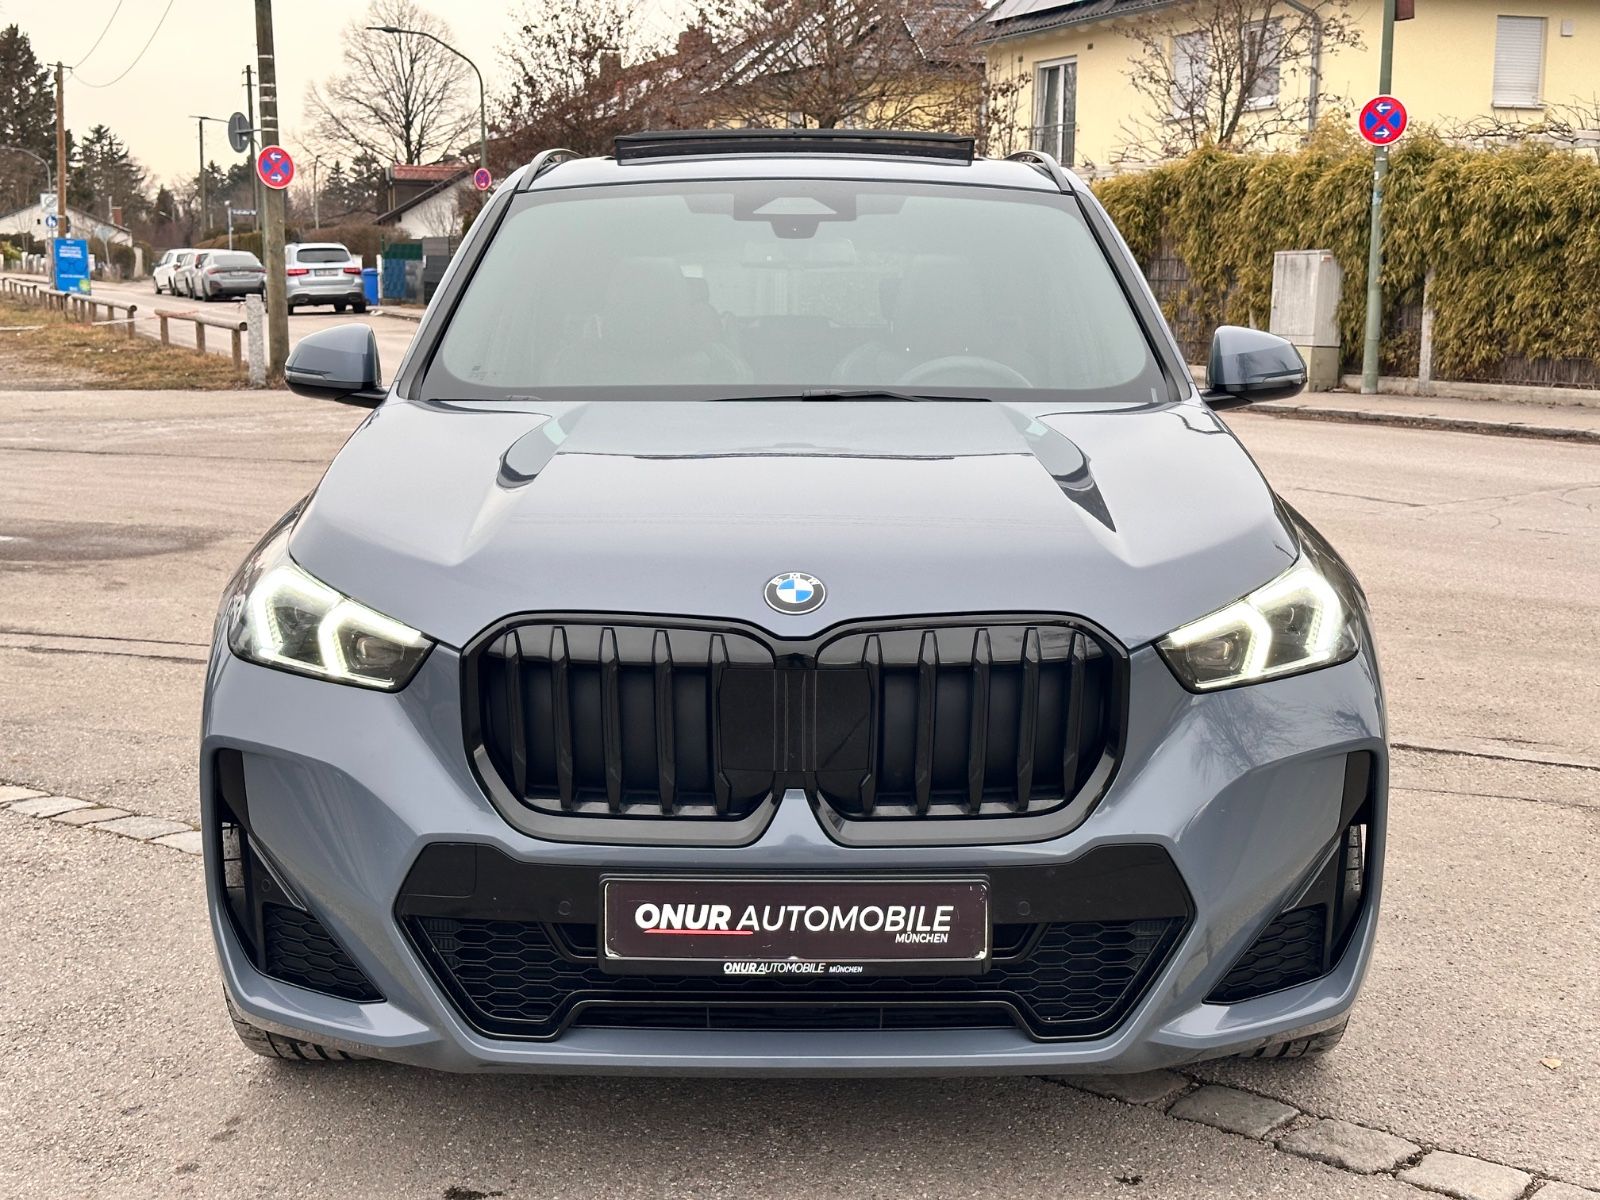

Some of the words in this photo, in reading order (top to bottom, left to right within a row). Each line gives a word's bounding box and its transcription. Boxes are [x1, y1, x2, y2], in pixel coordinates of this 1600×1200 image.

[634, 903, 732, 930] ONUR
[736, 905, 955, 932] AUTOMOBILE
[895, 931, 948, 944] MÜNCHEN
[829, 965, 863, 974] MÜNCHEN
